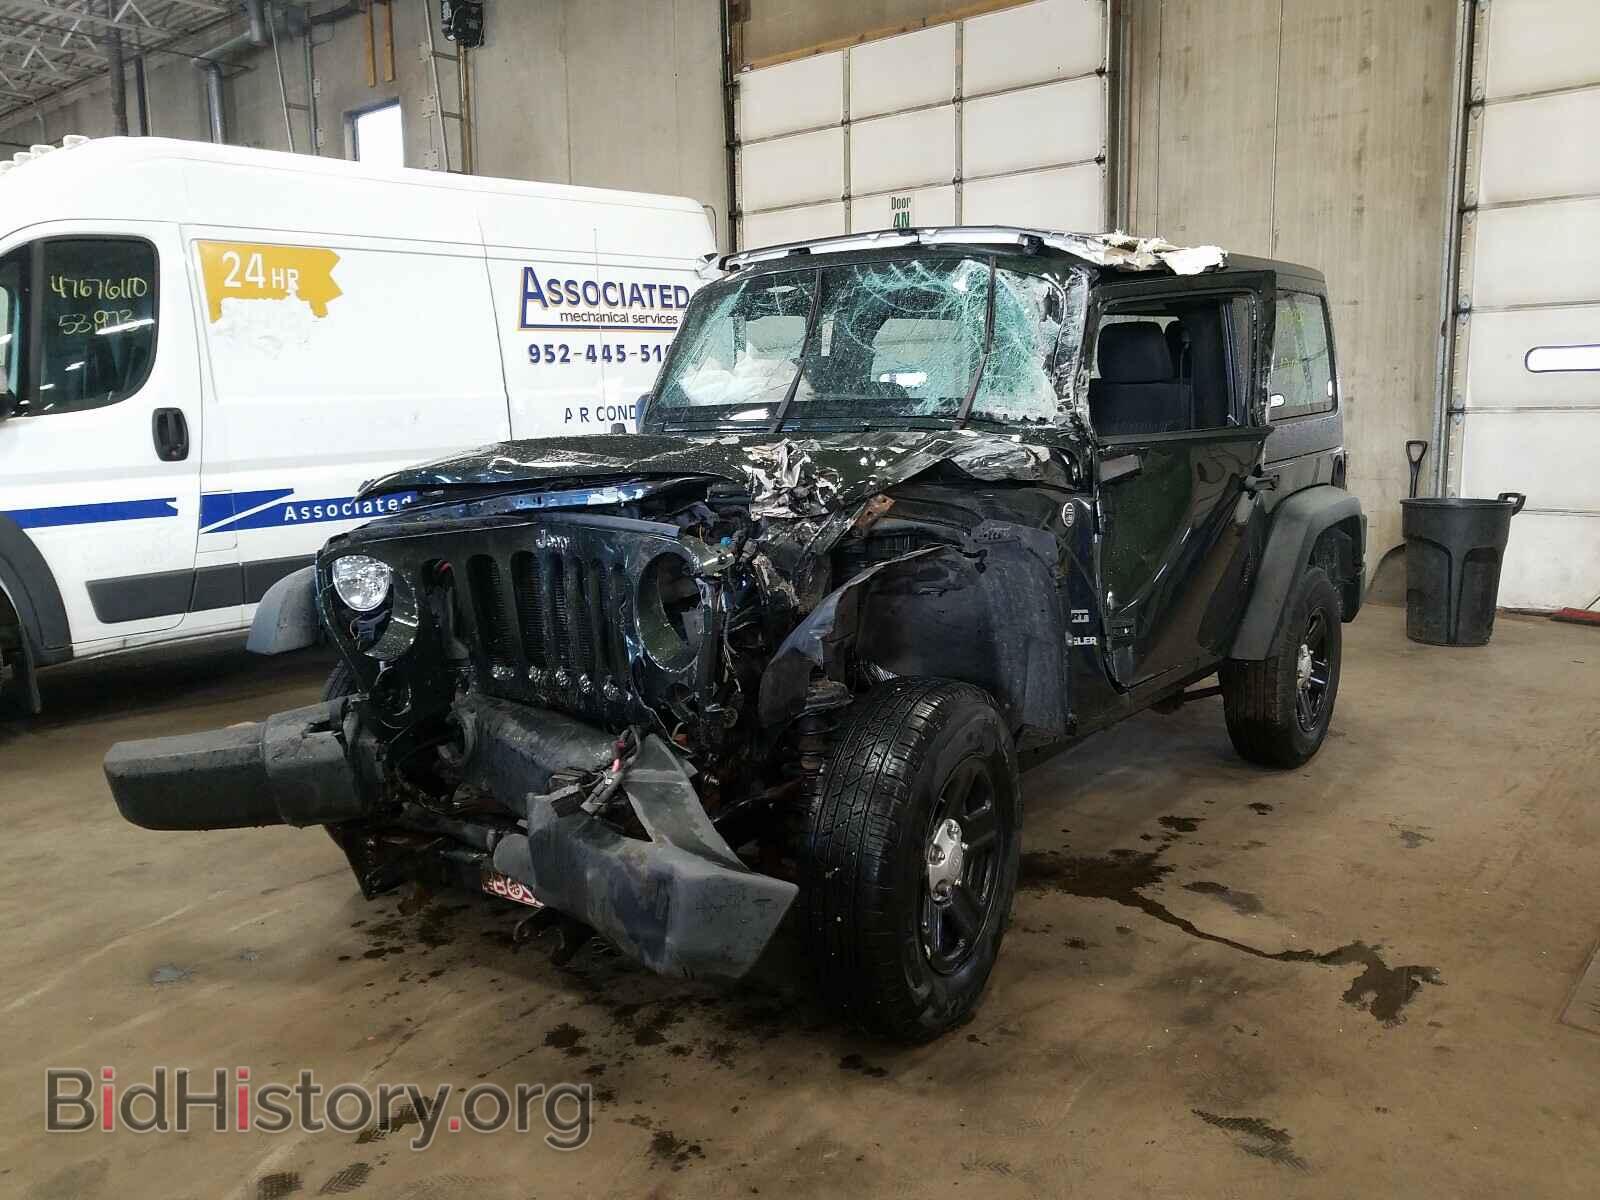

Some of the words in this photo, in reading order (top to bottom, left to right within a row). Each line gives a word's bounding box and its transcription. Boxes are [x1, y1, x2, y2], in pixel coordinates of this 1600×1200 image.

[891, 196, 911, 210] Door
[893, 211, 911, 229] 4N
[222, 250, 266, 288] 24
[271, 267, 299, 290] HR
[560, 311, 629, 323] mechanical
[632, 313, 679, 325] services
[528, 343, 672, 363] 952-445-51
